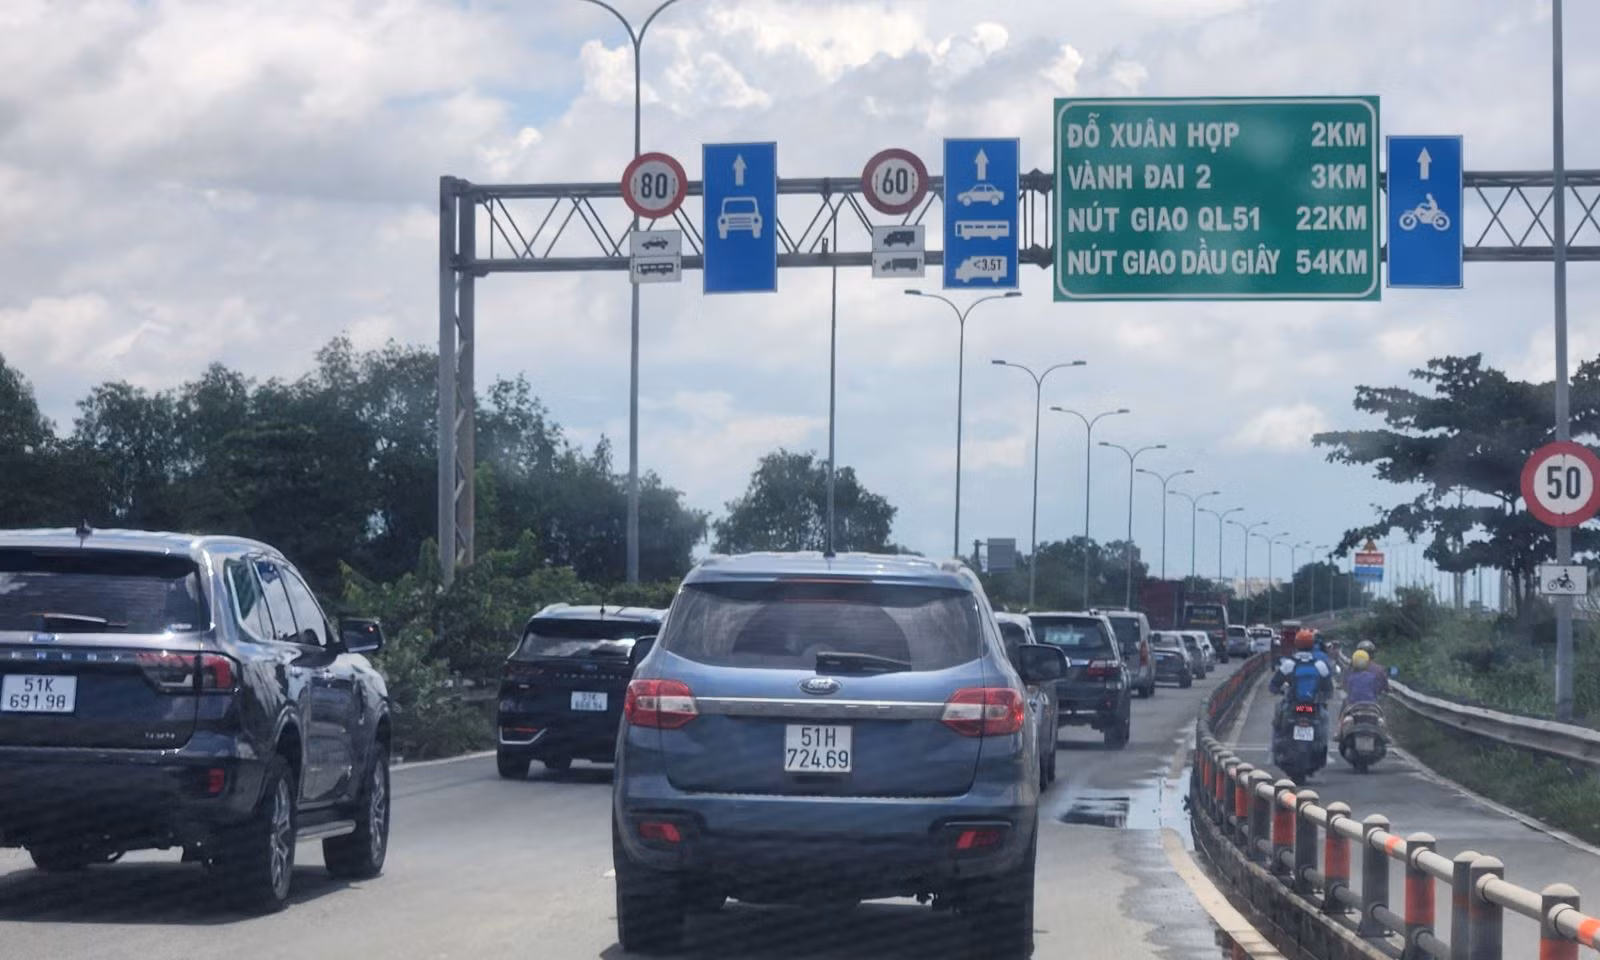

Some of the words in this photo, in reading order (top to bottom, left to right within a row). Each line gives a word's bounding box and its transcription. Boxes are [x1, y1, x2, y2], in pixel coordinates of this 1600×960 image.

[1067, 113, 1100, 149] ĐỖ
[1110, 117, 1176, 148] XUÂN
[1187, 122, 1240, 153] HỢP
[1311, 122, 1366, 147] 2KM
[640, 172, 668, 199] 80
[881, 167, 908, 195] 60
[1068, 160, 1133, 190] VÀNH
[1144, 165, 1184, 190] ĐAI
[1195, 165, 1212, 190] 2
[1311, 164, 1367, 189] 3KM
[1067, 201, 1120, 233] NÚT
[1131, 207, 1189, 232] GIAO
[1198, 206, 1261, 232] QL51
[1296, 206, 1367, 231] 22KM
[1067, 244, 1117, 275] NÚT
[1123, 249, 1176, 275] GIAO
[1182, 239, 1227, 275] DẦU
[1231, 244, 1281, 275] GIÂY
[1296, 249, 1368, 275] 54KM
[1547, 466, 1581, 500] 50
[24, 676, 55, 692] 51K
[801, 727, 836, 747] 51H
[787, 748, 849, 769] 724.69
